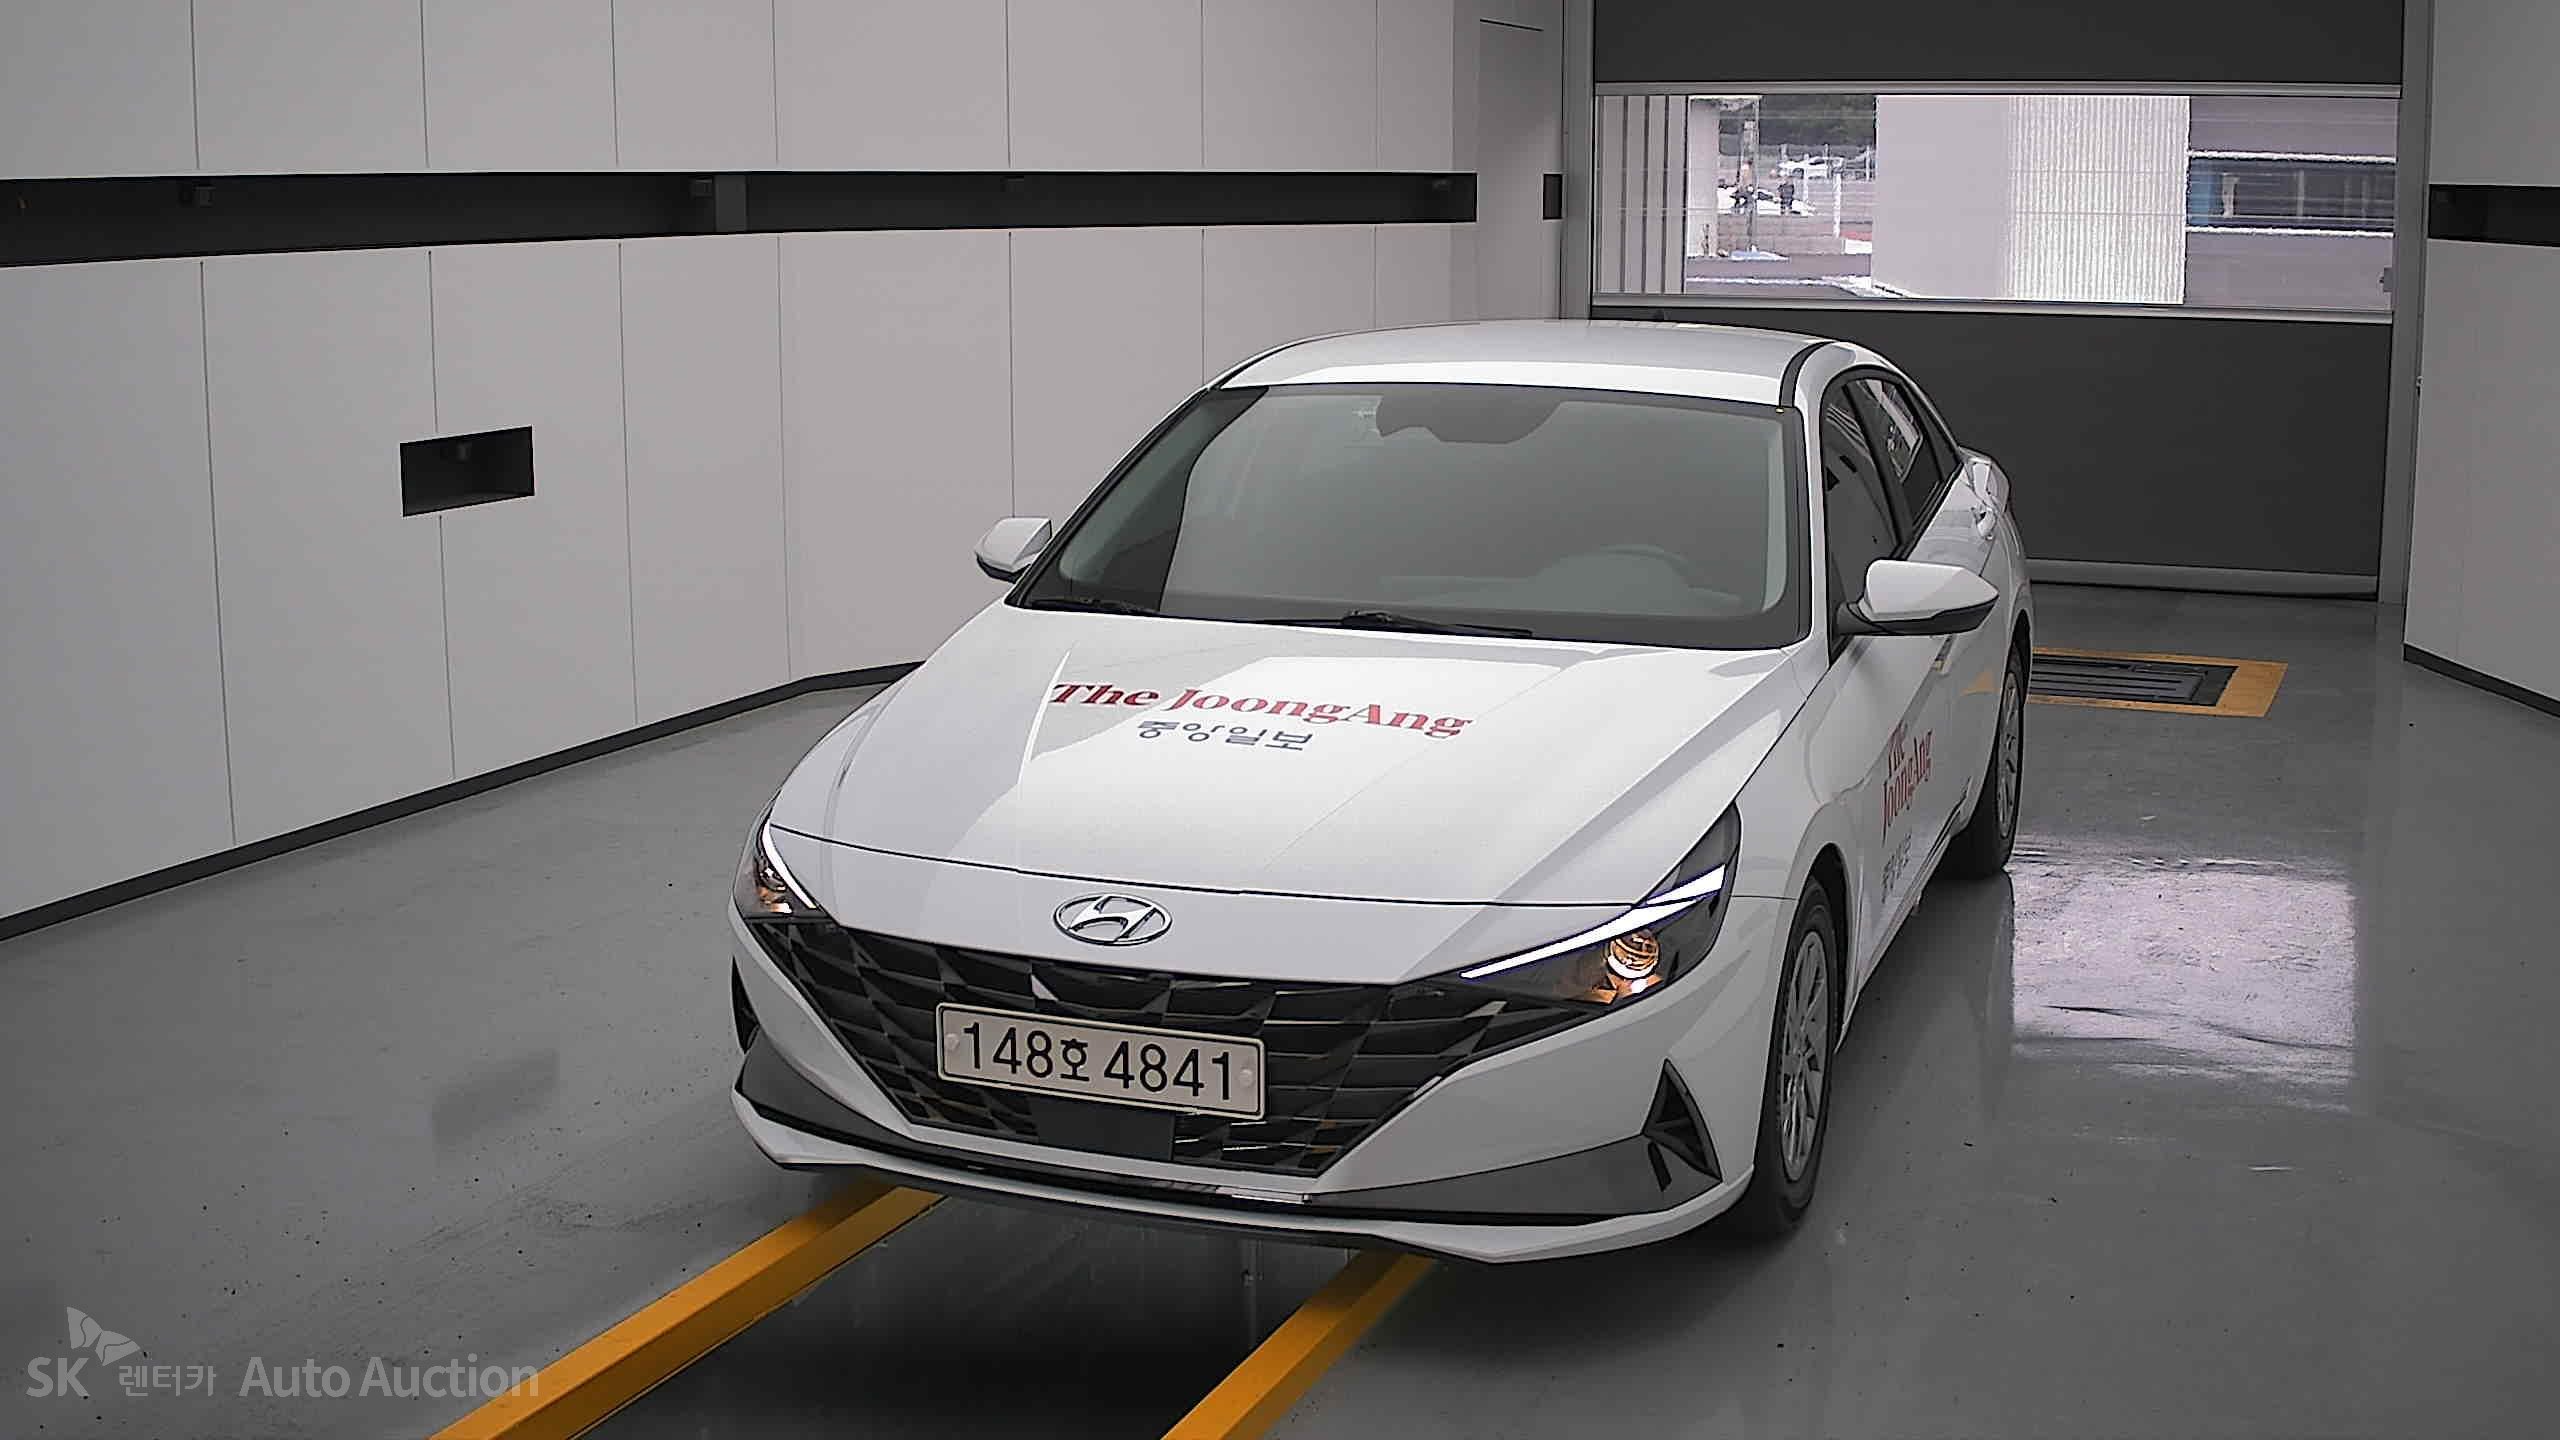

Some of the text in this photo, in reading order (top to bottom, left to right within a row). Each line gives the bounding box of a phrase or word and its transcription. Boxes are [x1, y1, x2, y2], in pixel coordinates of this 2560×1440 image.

[1051, 683, 1474, 739] The JoongAng
[1137, 719, 1313, 752] 중앙일보
[963, 1022, 1231, 1101] 148호 4841
